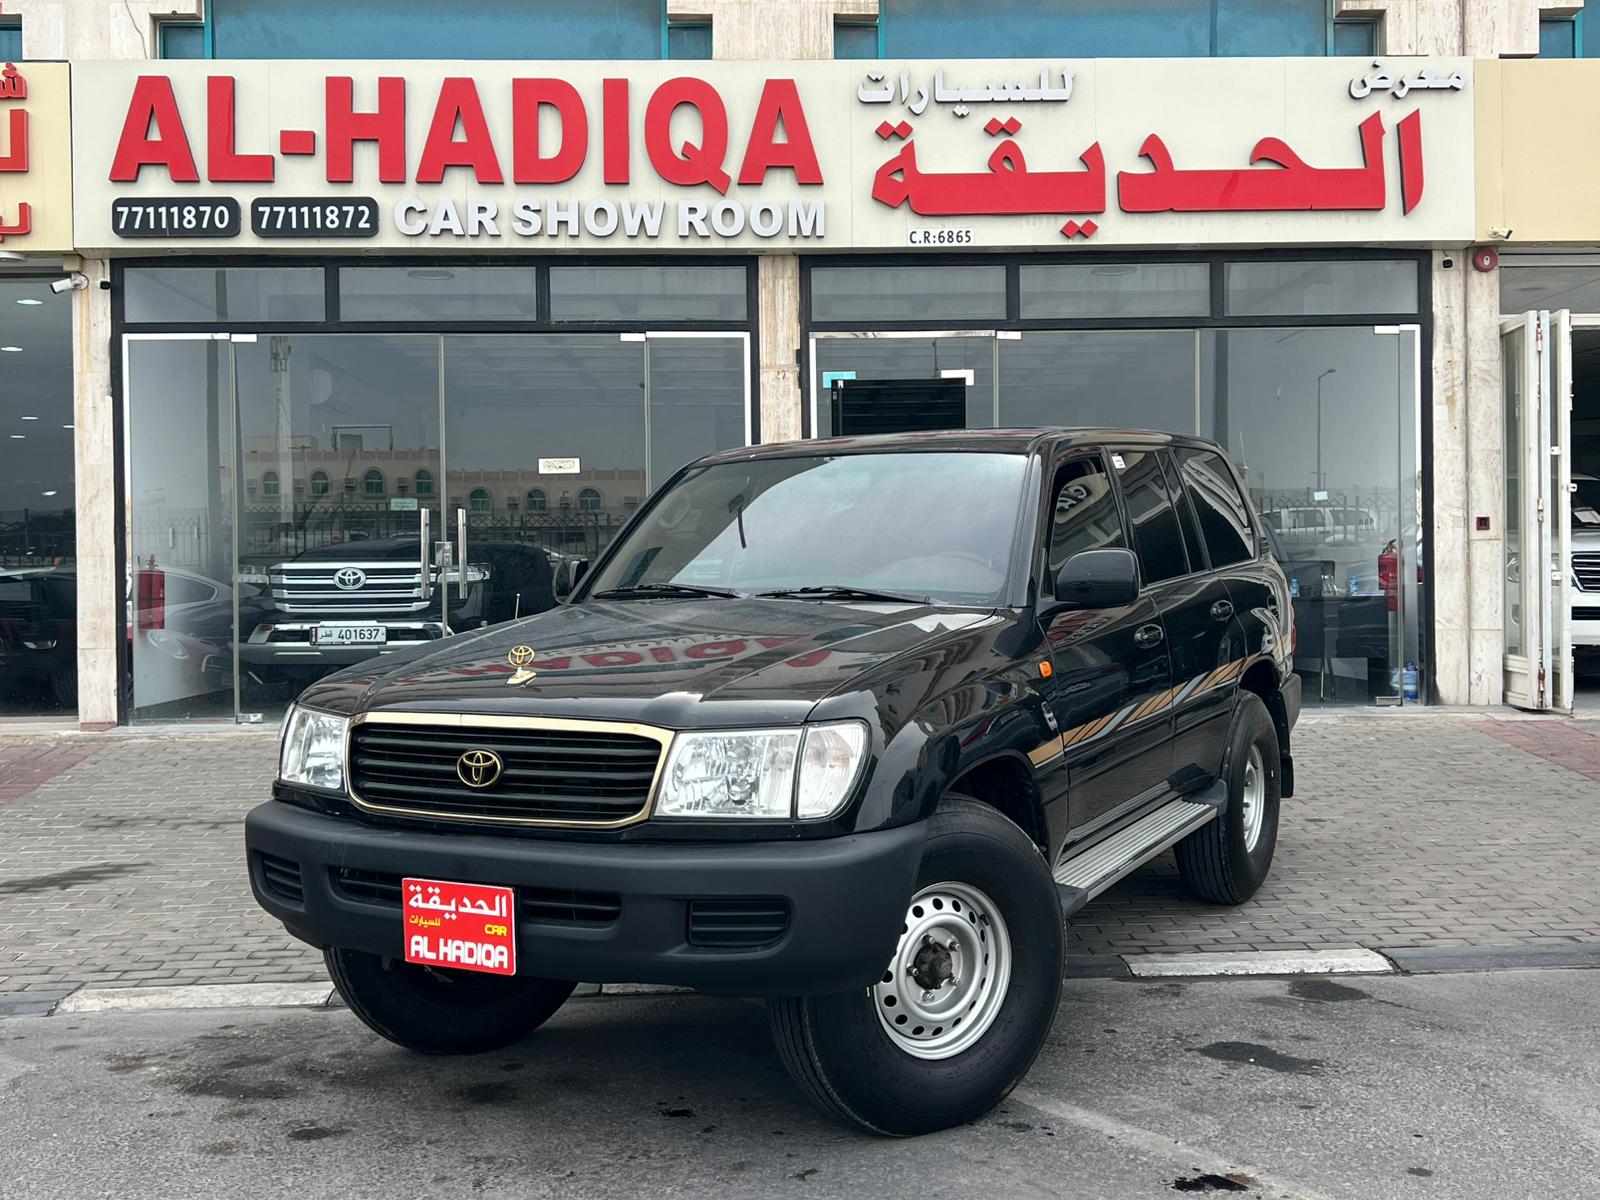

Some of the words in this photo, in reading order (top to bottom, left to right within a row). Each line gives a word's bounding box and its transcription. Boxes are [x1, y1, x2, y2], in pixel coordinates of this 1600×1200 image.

[857, 67, 1075, 118] للسيارات
[1348, 60, 1465, 100] معرض
[109, 75, 824, 197] AL-HADIQA
[871, 107, 1424, 239] الحديقة
[116, 205, 230, 229] 77111870
[257, 205, 371, 229] 77111872
[393, 199, 501, 237] CAR
[511, 199, 665, 237] SHOW
[678, 199, 825, 238] ROOM
[909, 230, 971, 244] C.R:6865
[338, 628, 380, 640] 401637
[408, 884, 507, 920] الحديقة
[484, 924, 508, 937] CAR
[410, 935, 437, 960] AL
[439, 938, 509, 969] HADIQA
